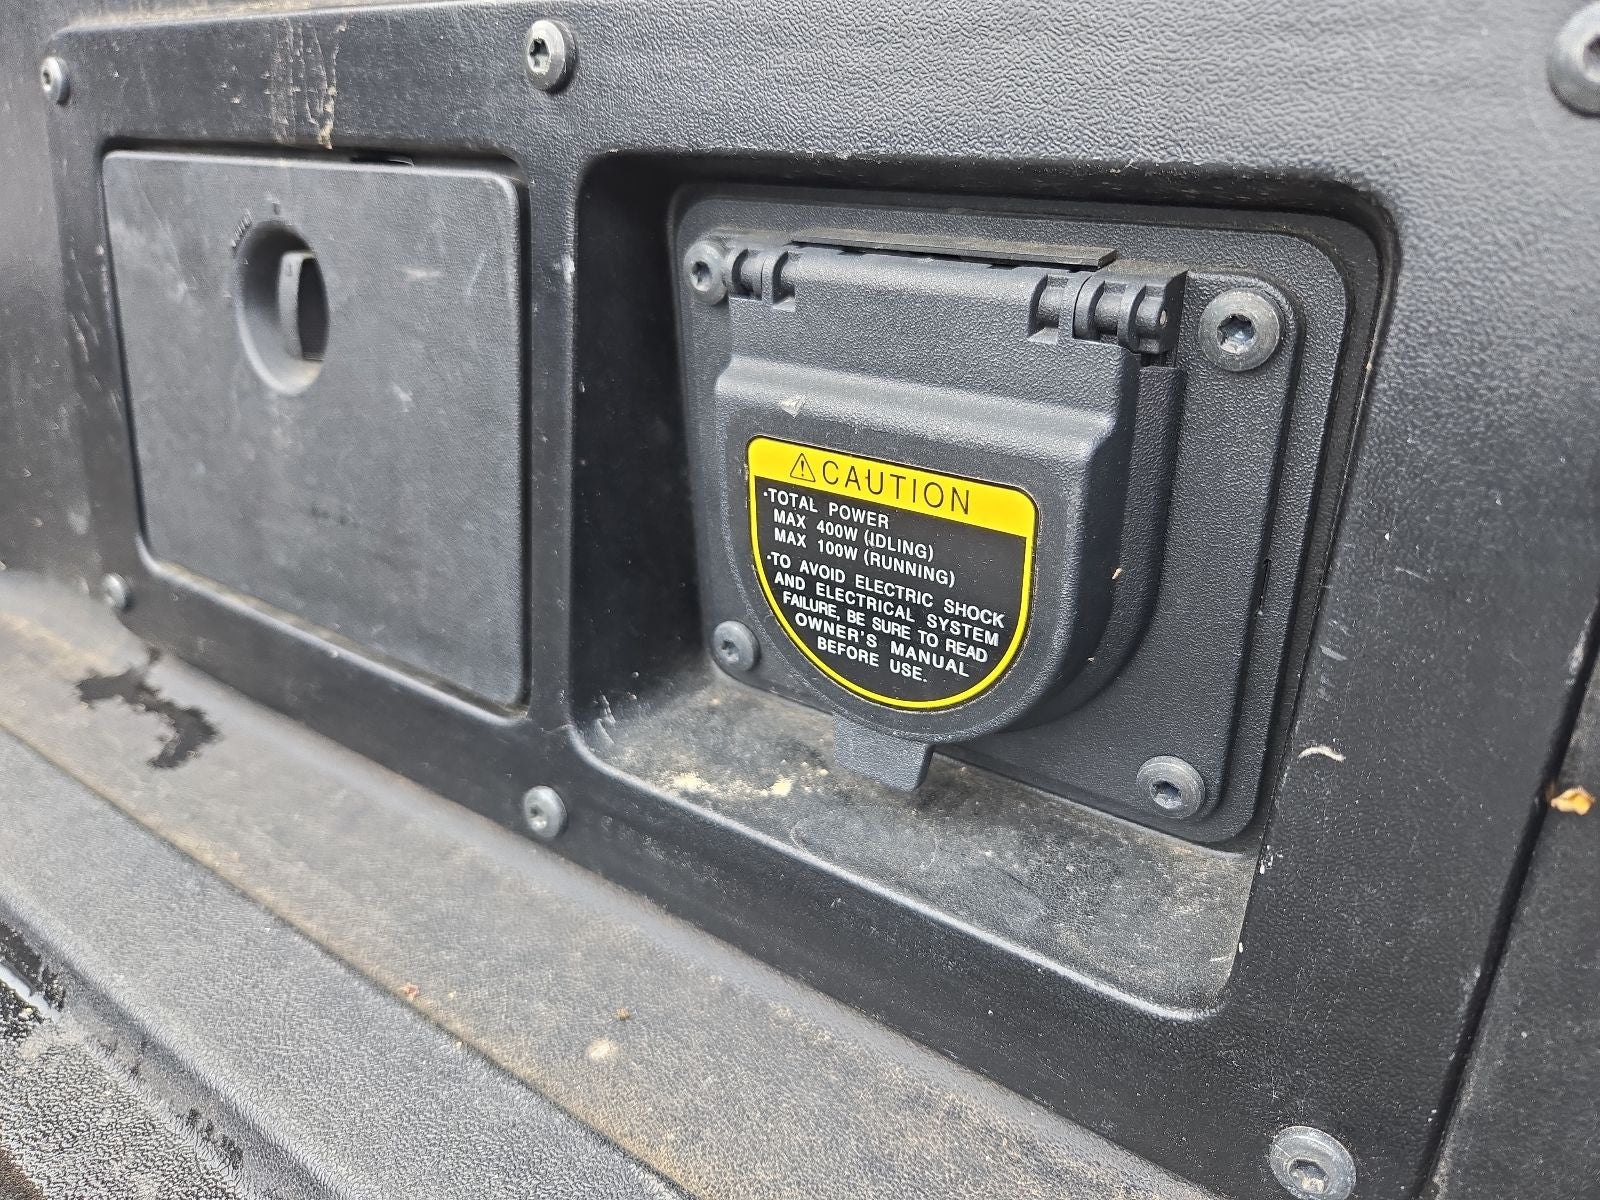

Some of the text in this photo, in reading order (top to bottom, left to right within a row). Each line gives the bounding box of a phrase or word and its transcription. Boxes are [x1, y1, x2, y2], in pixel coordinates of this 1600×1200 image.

[822, 460, 970, 515] CAUTION
[829, 502, 889, 529] POWER
[773, 509, 934, 561] MAX 400W (IDLING)
[774, 527, 956, 587] MAX 100W (RUNNING)
[774, 571, 999, 647] AND ELECTRICAL SYSTEM
[799, 559, 846, 584] AVOID
[855, 574, 934, 608] ELECTRIC
[943, 599, 1005, 628] SHOCK
[782, 590, 988, 663] FAILURE, BE SURE TO READ
[795, 612, 970, 678] OWNER'S MANUAL
[816, 635, 928, 682] BEFORE USE.
